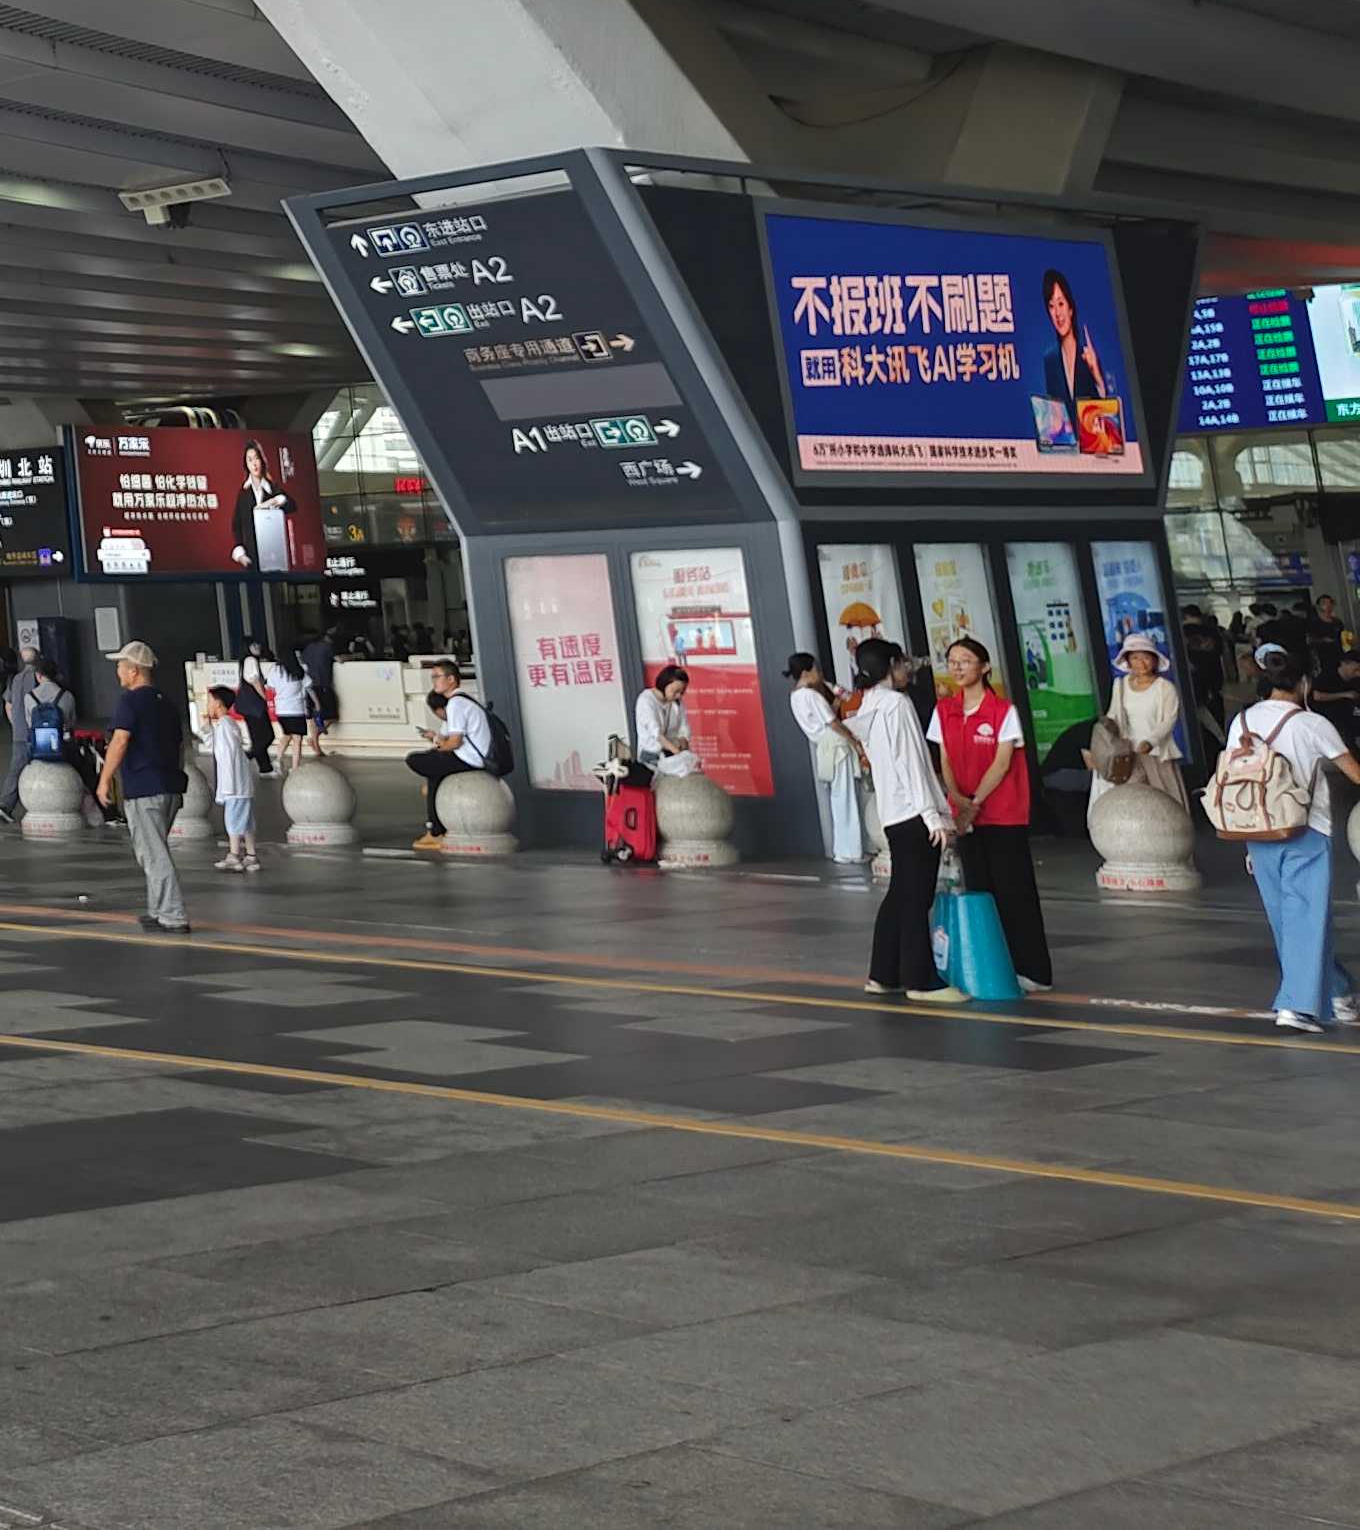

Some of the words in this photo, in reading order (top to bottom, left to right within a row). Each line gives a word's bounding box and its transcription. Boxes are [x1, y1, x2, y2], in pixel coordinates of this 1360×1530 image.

[422, 215, 488, 237] 东进站口
[420, 262, 469, 283] 售票处
[471, 256, 515, 285] A2
[465, 300, 516, 321] 出站口
[520, 294, 564, 324] A2
[790, 274, 1015, 336] 不报班不刷题
[511, 426, 548, 455] A1
[543, 422, 594, 443] 出站口
[619, 458, 676, 479] 西广场
[536, 633, 601, 660] 有速度
[527, 660, 617, 688] 更有温度
